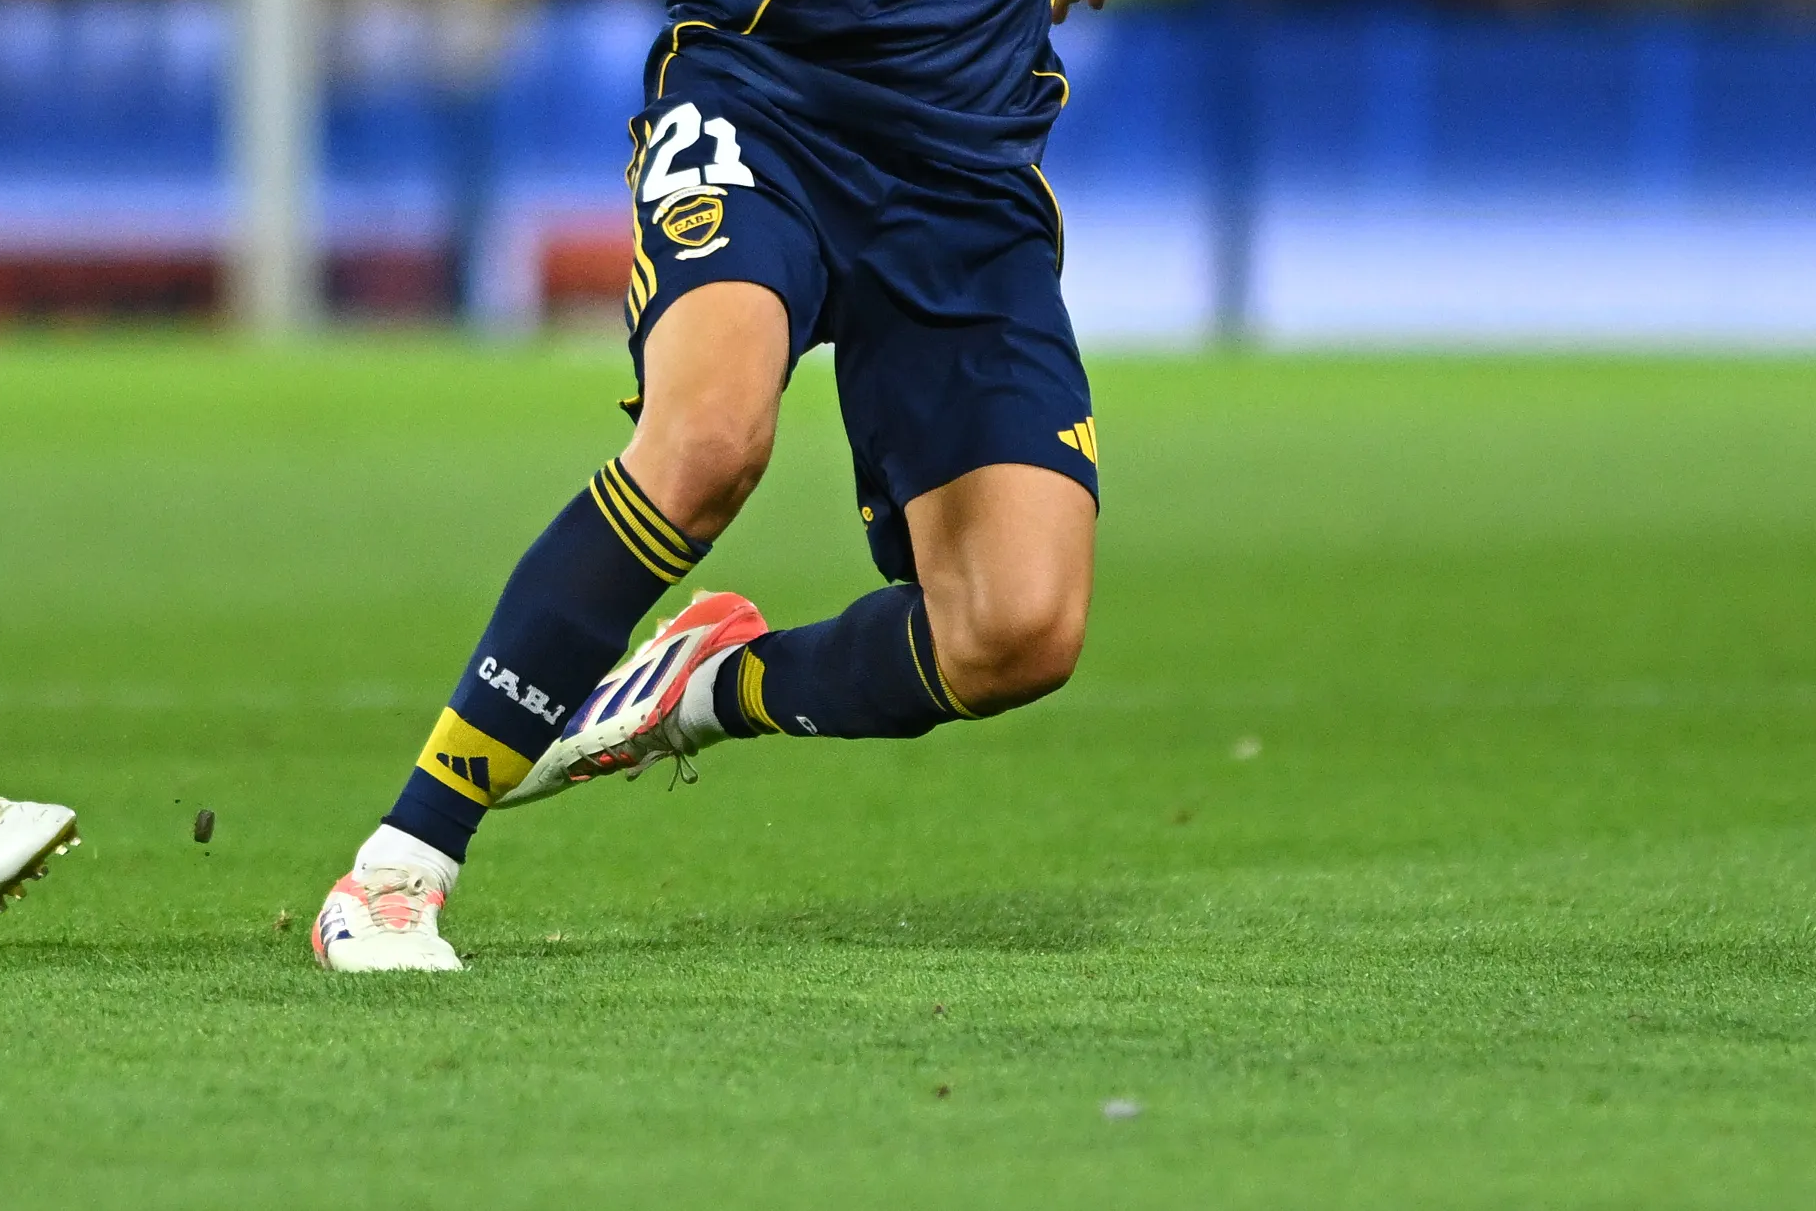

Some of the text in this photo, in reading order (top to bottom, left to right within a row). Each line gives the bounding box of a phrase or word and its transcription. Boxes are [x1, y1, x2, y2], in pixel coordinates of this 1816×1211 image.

[643, 102, 756, 203] 21
[674, 212, 714, 233] CABJ
[478, 656, 566, 726] CABJ
